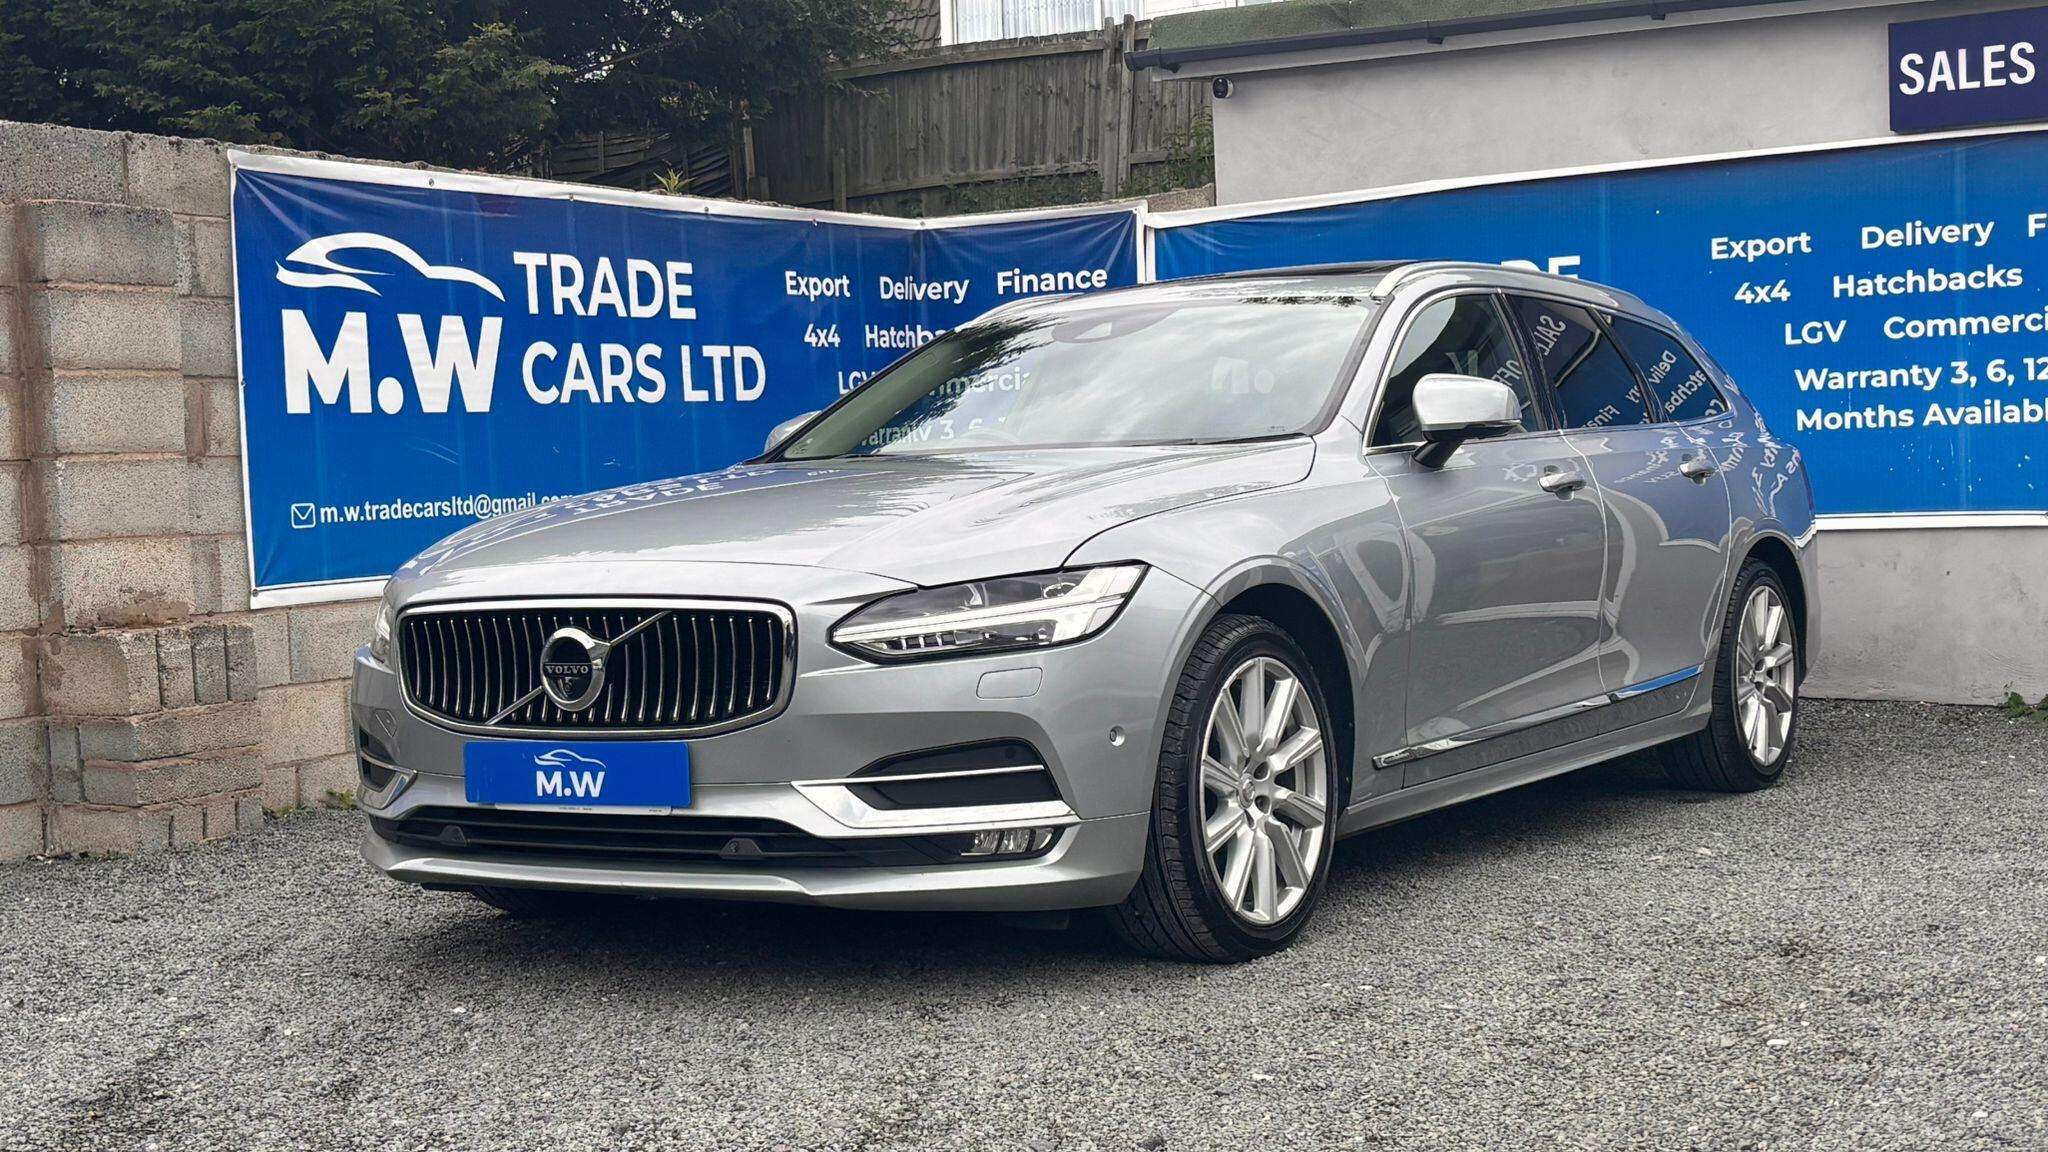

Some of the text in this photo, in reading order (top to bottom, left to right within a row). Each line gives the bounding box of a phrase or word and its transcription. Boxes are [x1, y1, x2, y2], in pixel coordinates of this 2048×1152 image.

[1899, 42, 2036, 95] SALES
[1711, 232, 1812, 262] Export
[1861, 220, 1995, 249] Delivery
[513, 251, 697, 320] TRADE
[785, 268, 1108, 305] Export Delivery Finance
[1734, 264, 2023, 304] 4x4 Hatchbacks
[804, 324, 841, 348] 4x4
[1785, 320, 1847, 345] LGV
[281, 309, 503, 415] M.W
[522, 341, 766, 405] CARS LTD
[1794, 363, 1942, 392] Warranty
[1950, 361, 1977, 388] 3,
[1986, 359, 2015, 386] 6,
[1796, 404, 1914, 431] Months
[545, 665, 589, 674] VOLVO
[536, 771, 606, 798] M.W
